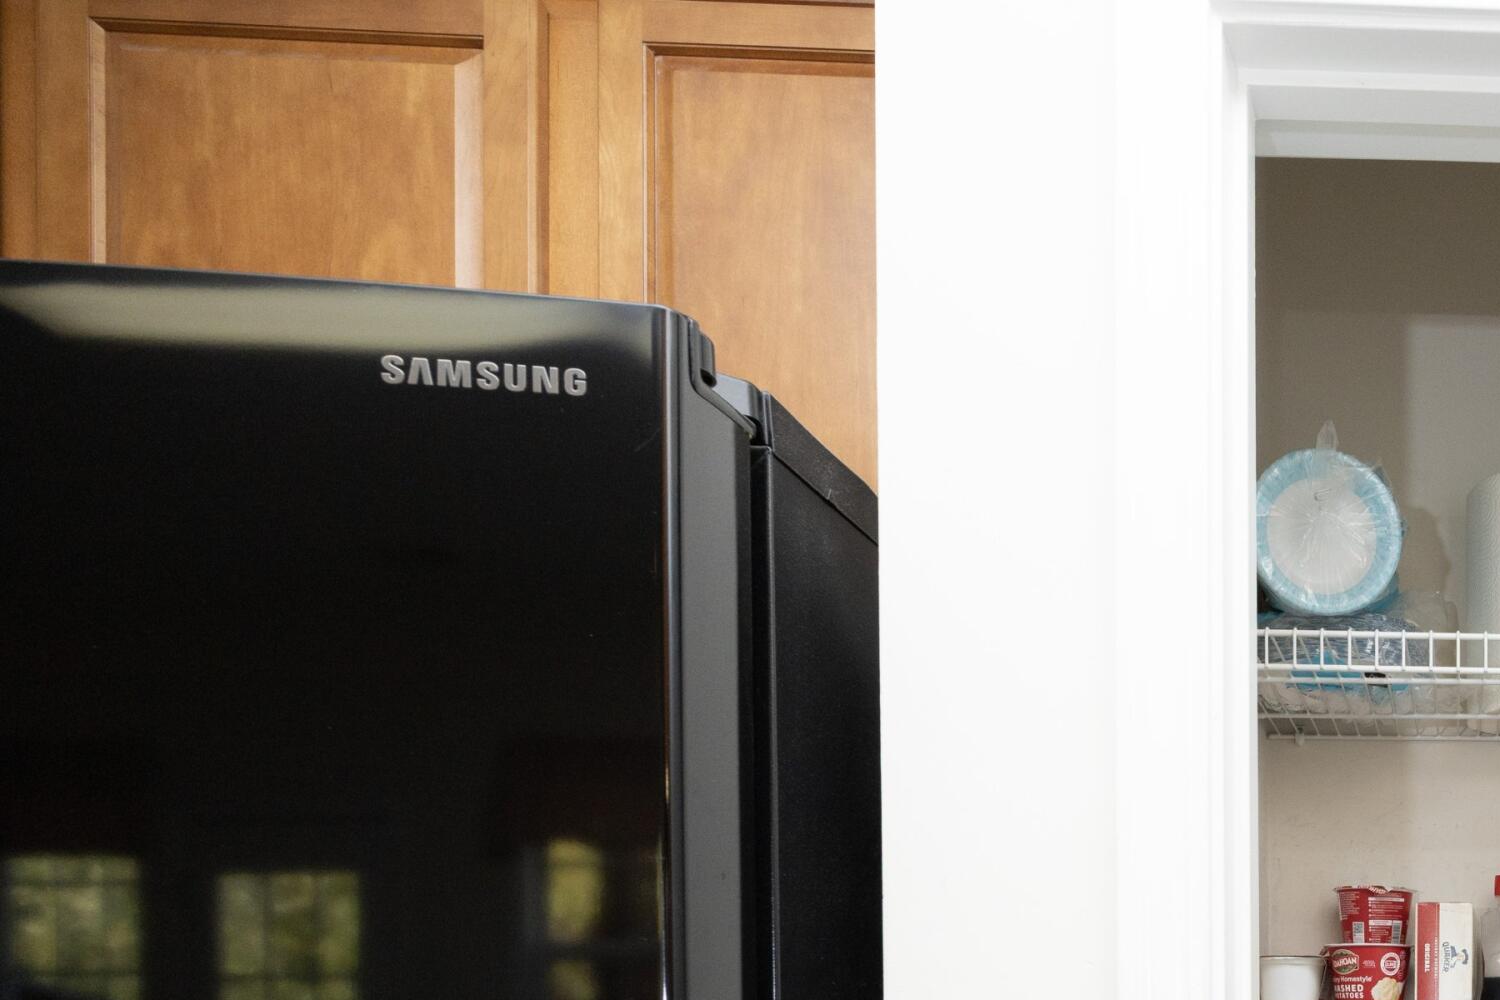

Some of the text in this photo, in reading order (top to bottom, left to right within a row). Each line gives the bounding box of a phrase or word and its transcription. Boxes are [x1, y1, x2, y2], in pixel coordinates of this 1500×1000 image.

[380, 354, 588, 397] SAMSUNG
[1442, 941, 1450, 973] QUAKER
[1341, 974, 1372, 983] Homestyle
